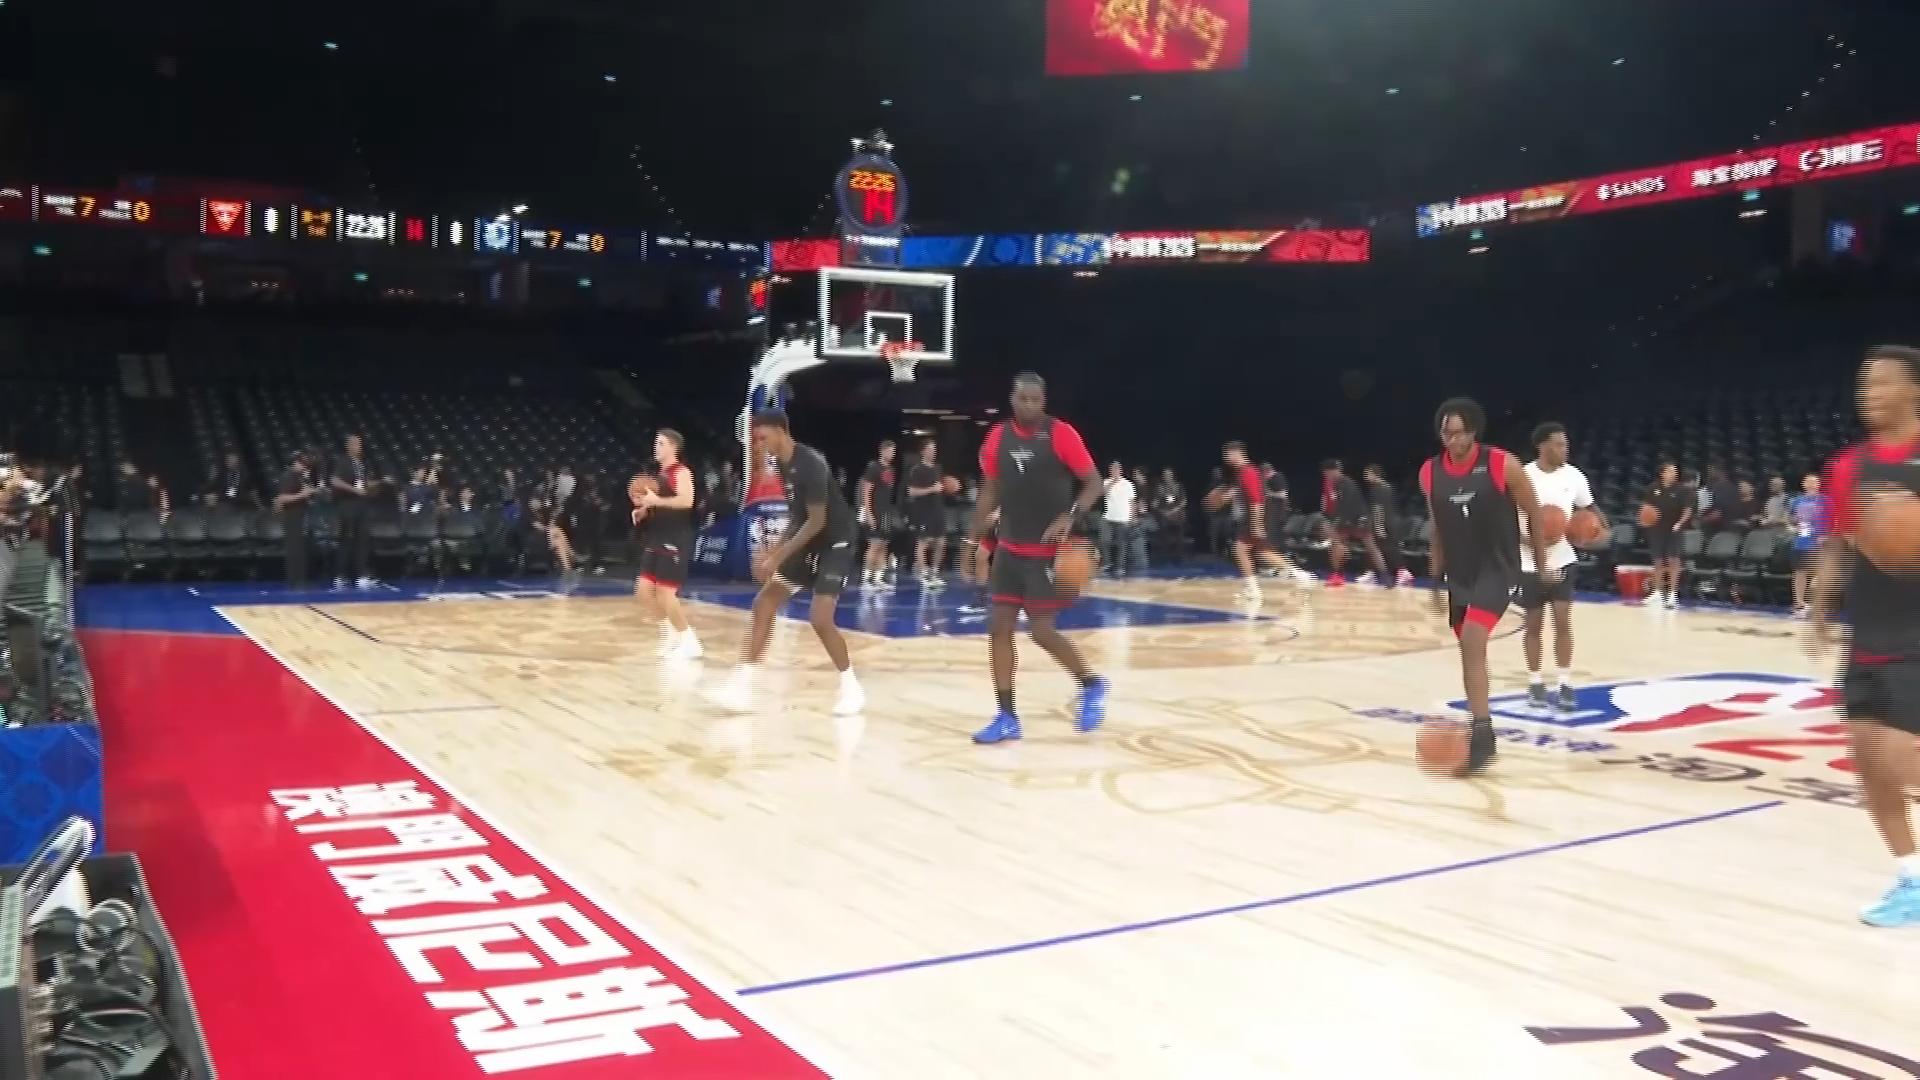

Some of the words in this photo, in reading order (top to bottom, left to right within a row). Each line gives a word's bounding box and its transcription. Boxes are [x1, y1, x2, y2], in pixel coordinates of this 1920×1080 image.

[1611, 175, 1666, 199] SANDS
[79, 196, 96, 218] 7
[132, 200, 150, 221] 0
[345, 212, 387, 239] 22:26
[547, 230, 562, 249] 7
[590, 233, 606, 252] 0
